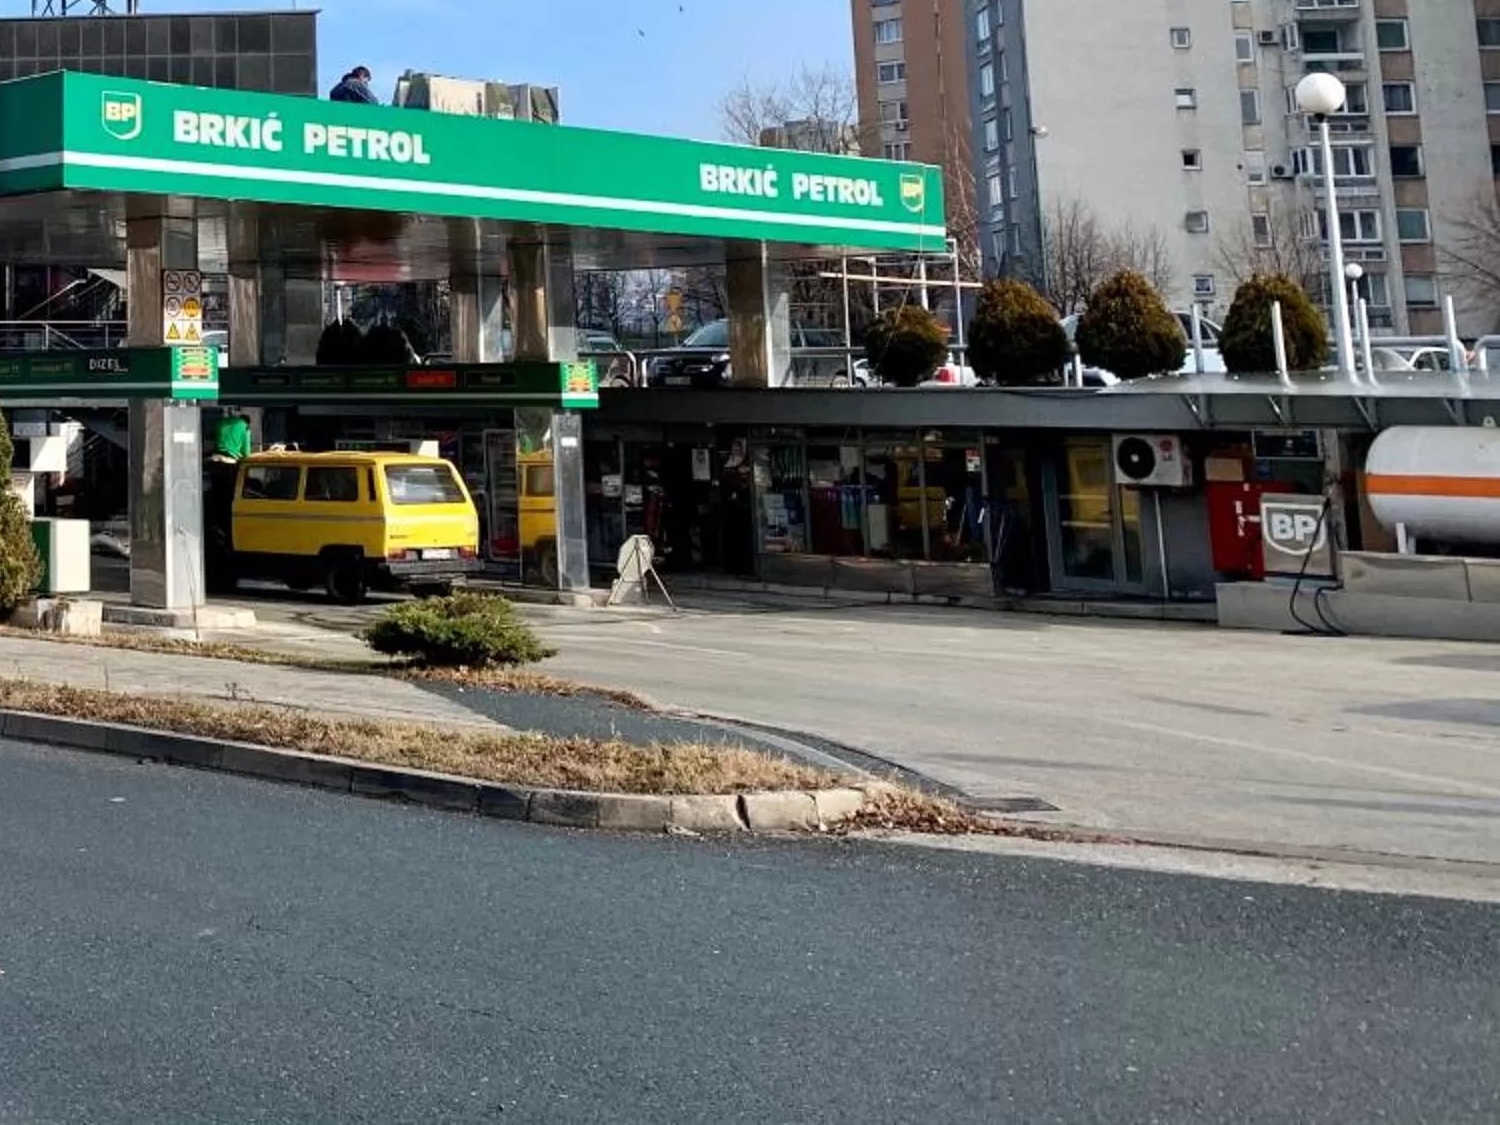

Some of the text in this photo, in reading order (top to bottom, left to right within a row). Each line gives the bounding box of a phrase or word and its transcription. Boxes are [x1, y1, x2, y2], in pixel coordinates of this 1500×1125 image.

[104, 101, 136, 123] BP
[173, 110, 431, 165] BRKIĆ PETROL
[699, 163, 884, 207] BRKIĆ PETROL
[1271, 512, 1318, 541] BP
